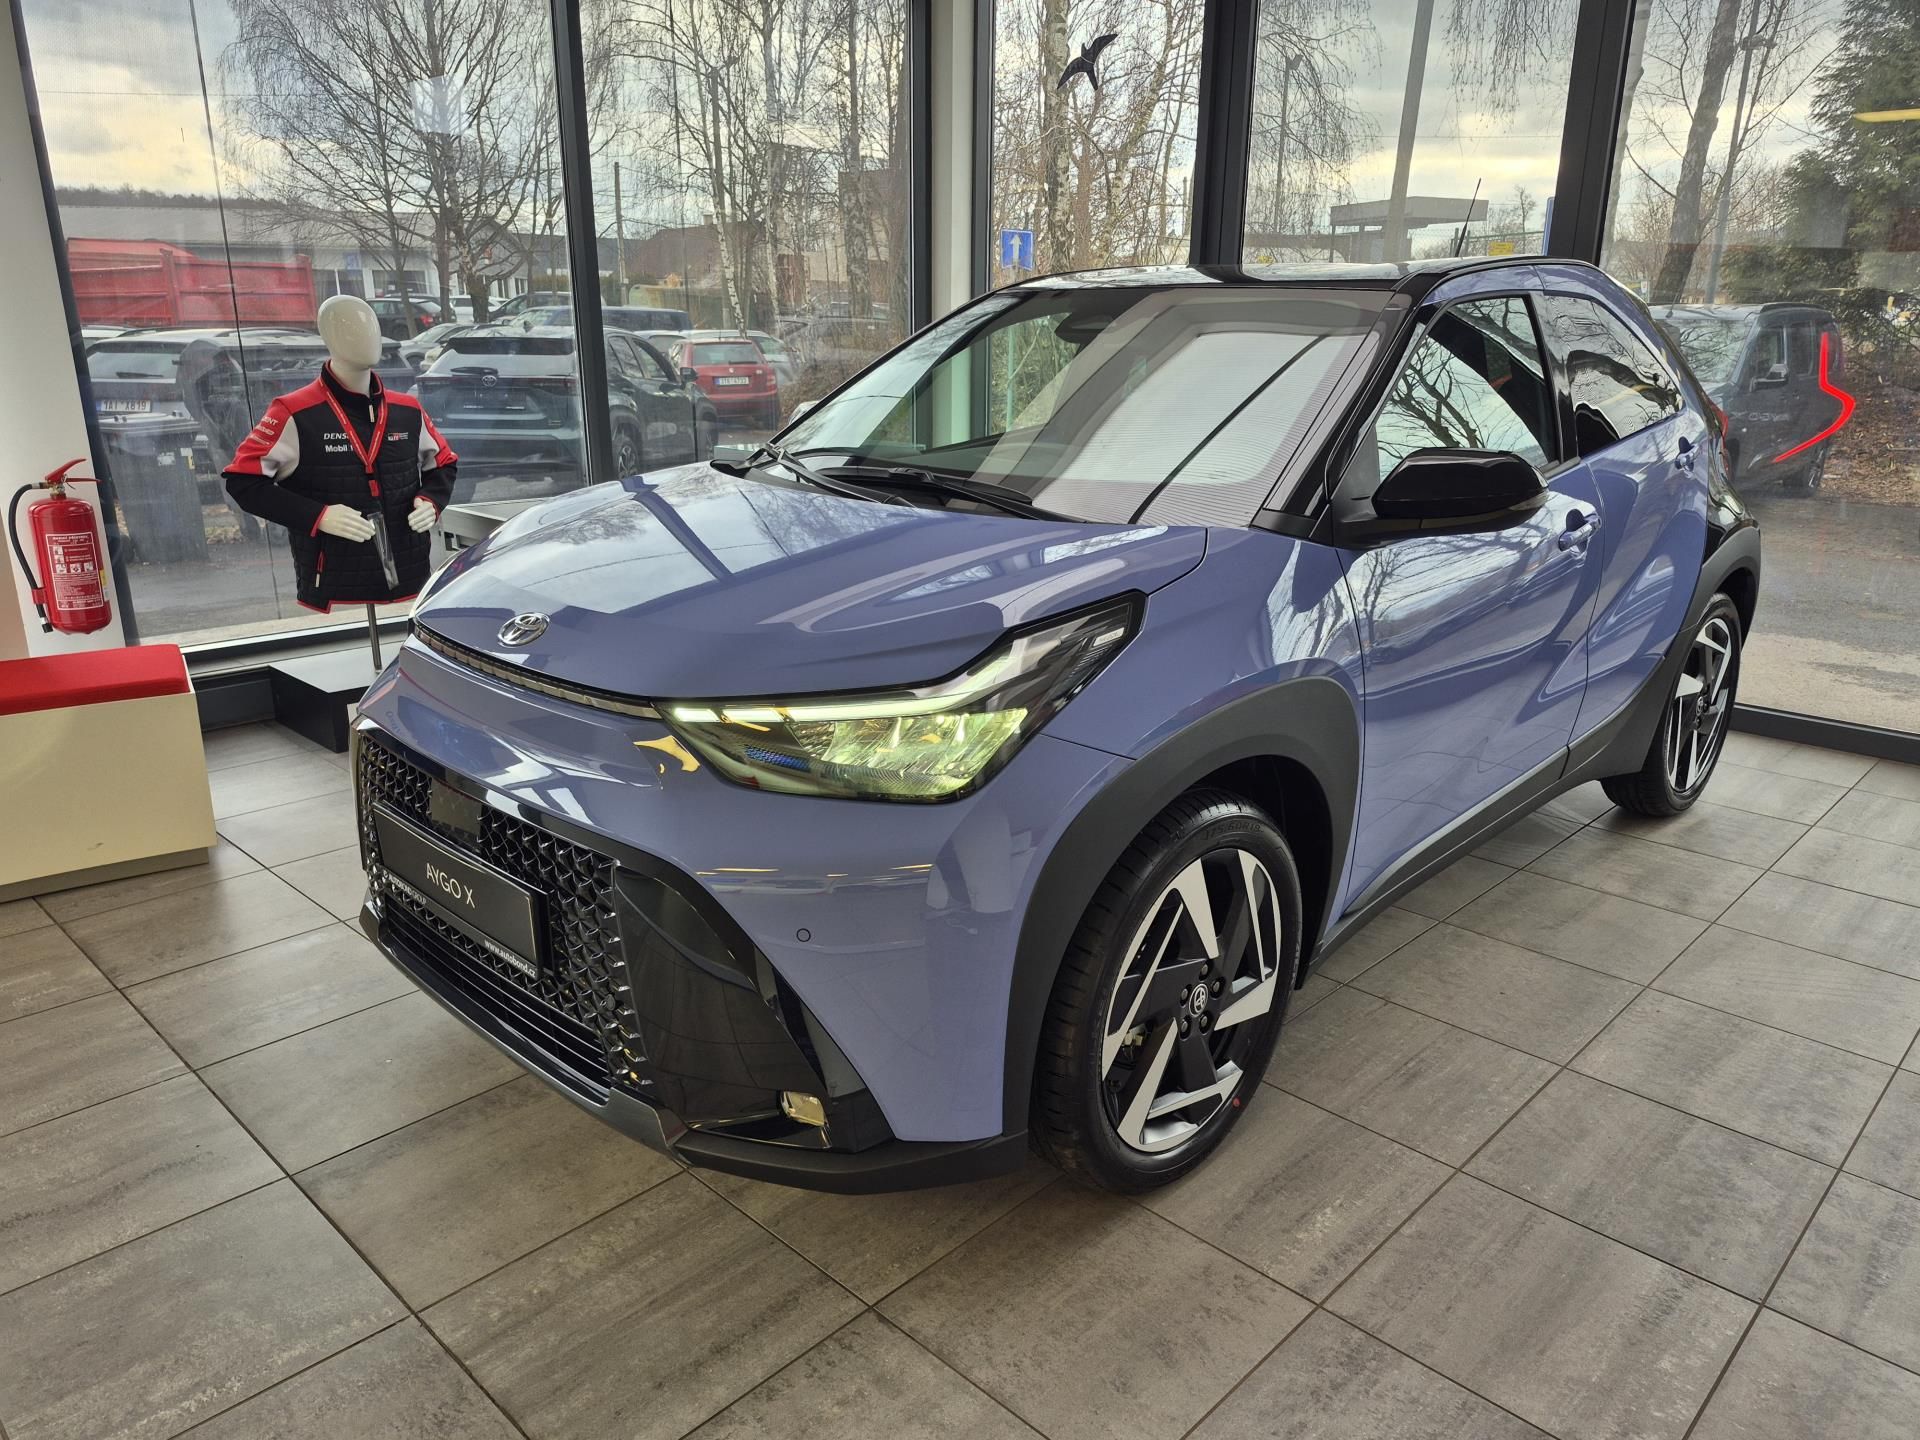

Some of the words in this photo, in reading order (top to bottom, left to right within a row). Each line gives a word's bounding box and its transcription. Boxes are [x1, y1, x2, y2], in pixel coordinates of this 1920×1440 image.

[323, 432, 349, 440] DENS
[325, 444, 348, 453] Mobil
[426, 862, 461, 899] AYGO
[464, 885, 476, 909] X
[484, 939, 536, 978] www.autobond.cz
